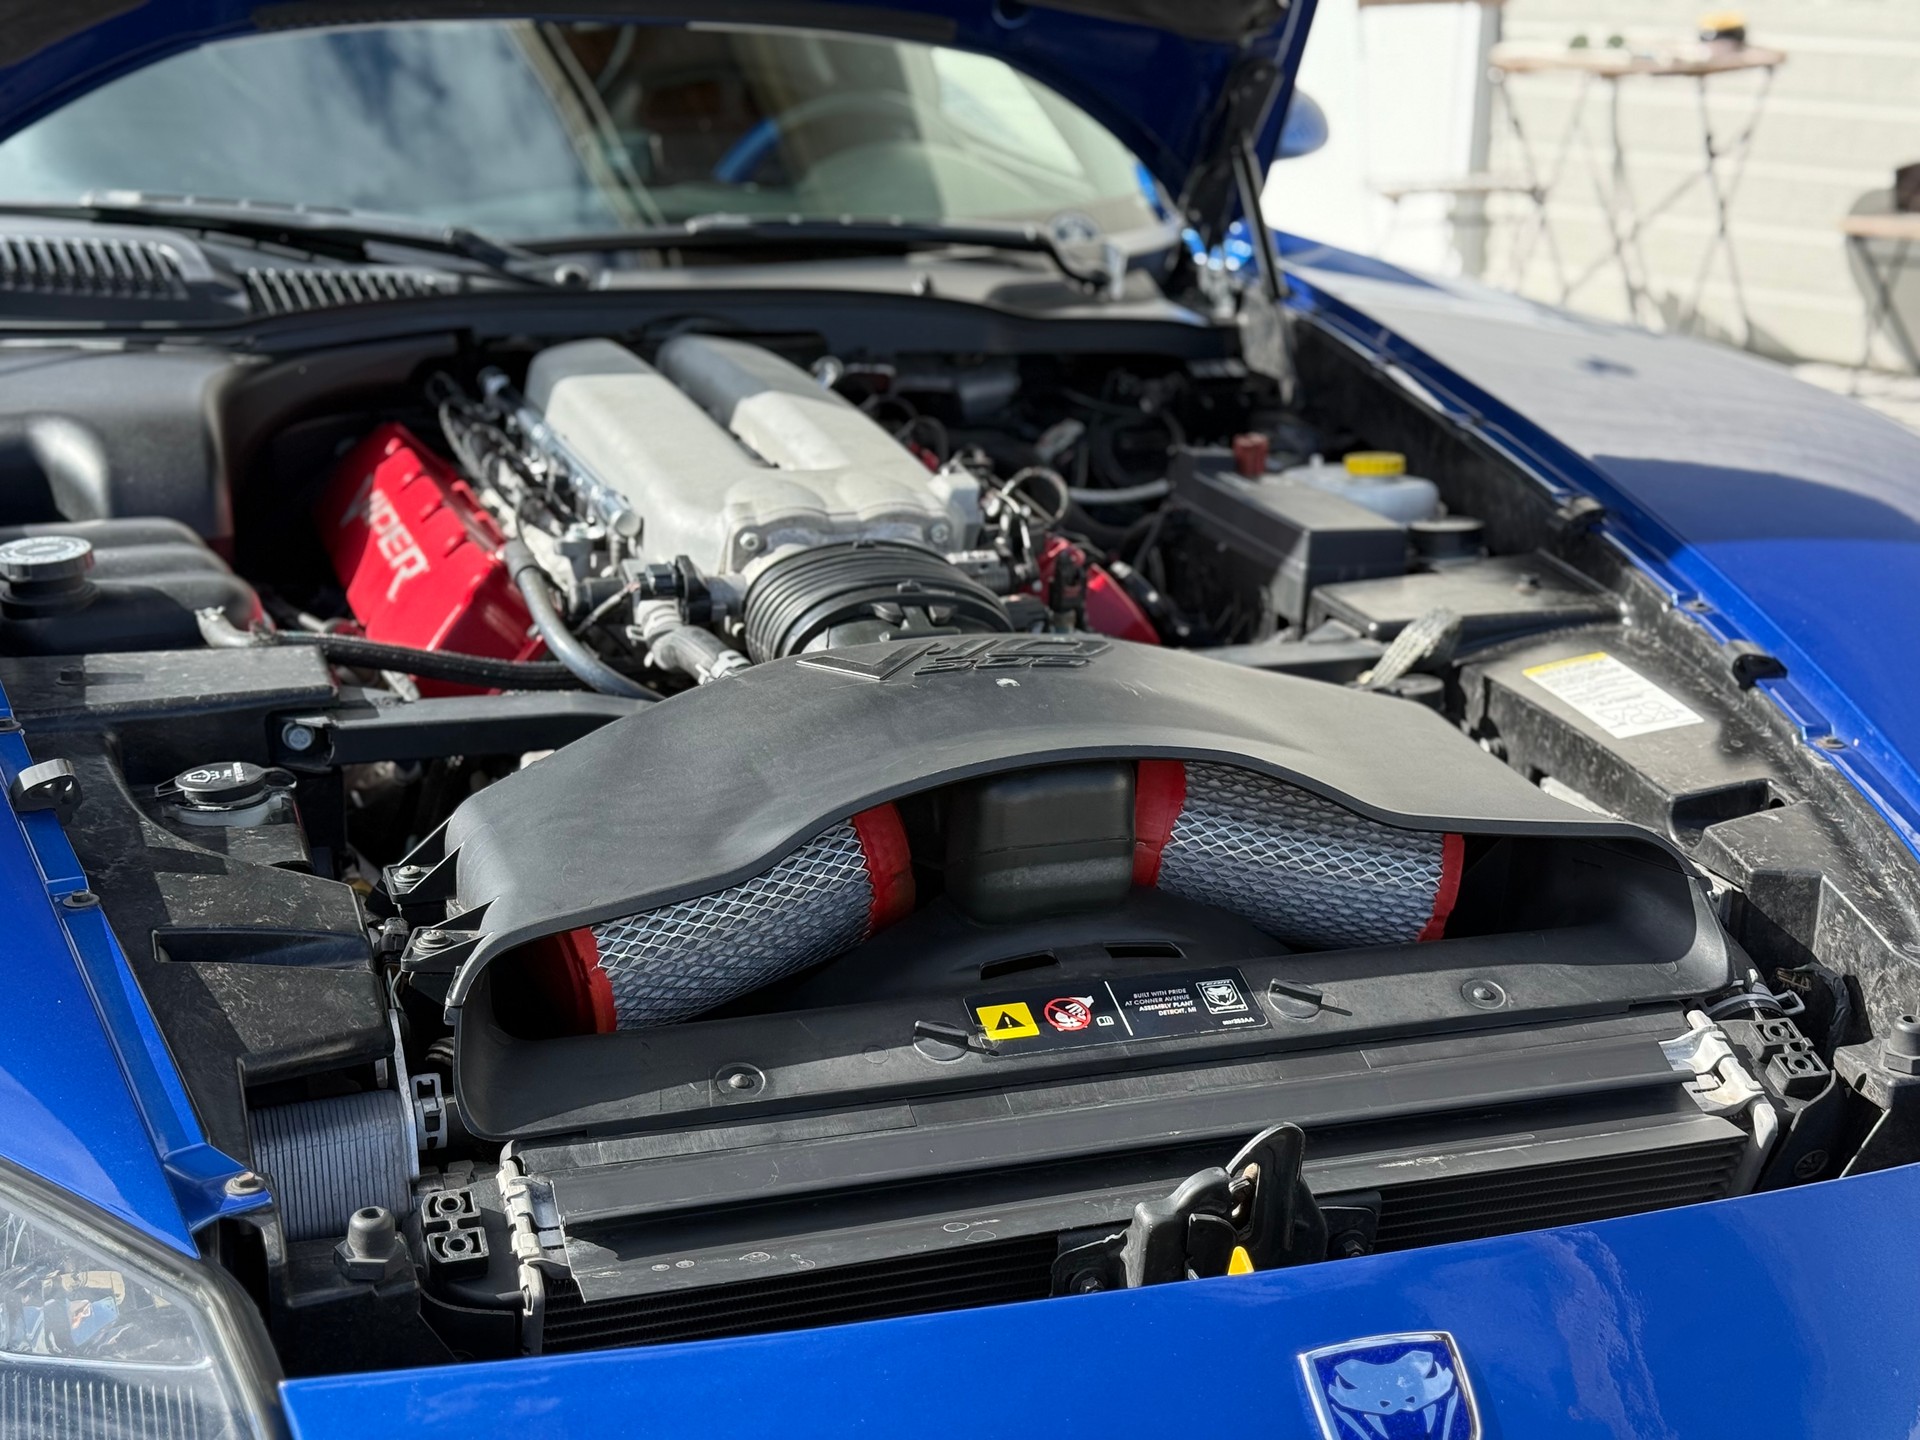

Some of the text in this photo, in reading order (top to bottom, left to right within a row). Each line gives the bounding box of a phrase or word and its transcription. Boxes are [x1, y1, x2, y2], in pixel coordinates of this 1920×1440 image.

[1133, 991, 1150, 999] BUILT
[1151, 989, 1167, 997] WITH
[1133, 997, 1163, 1005] CONNER
[1164, 994, 1190, 1002] AVENUE
[1139, 1000, 1193, 1011] ASSEMBLY PLANT
[1158, 1007, 1187, 1016] DETROIT,
